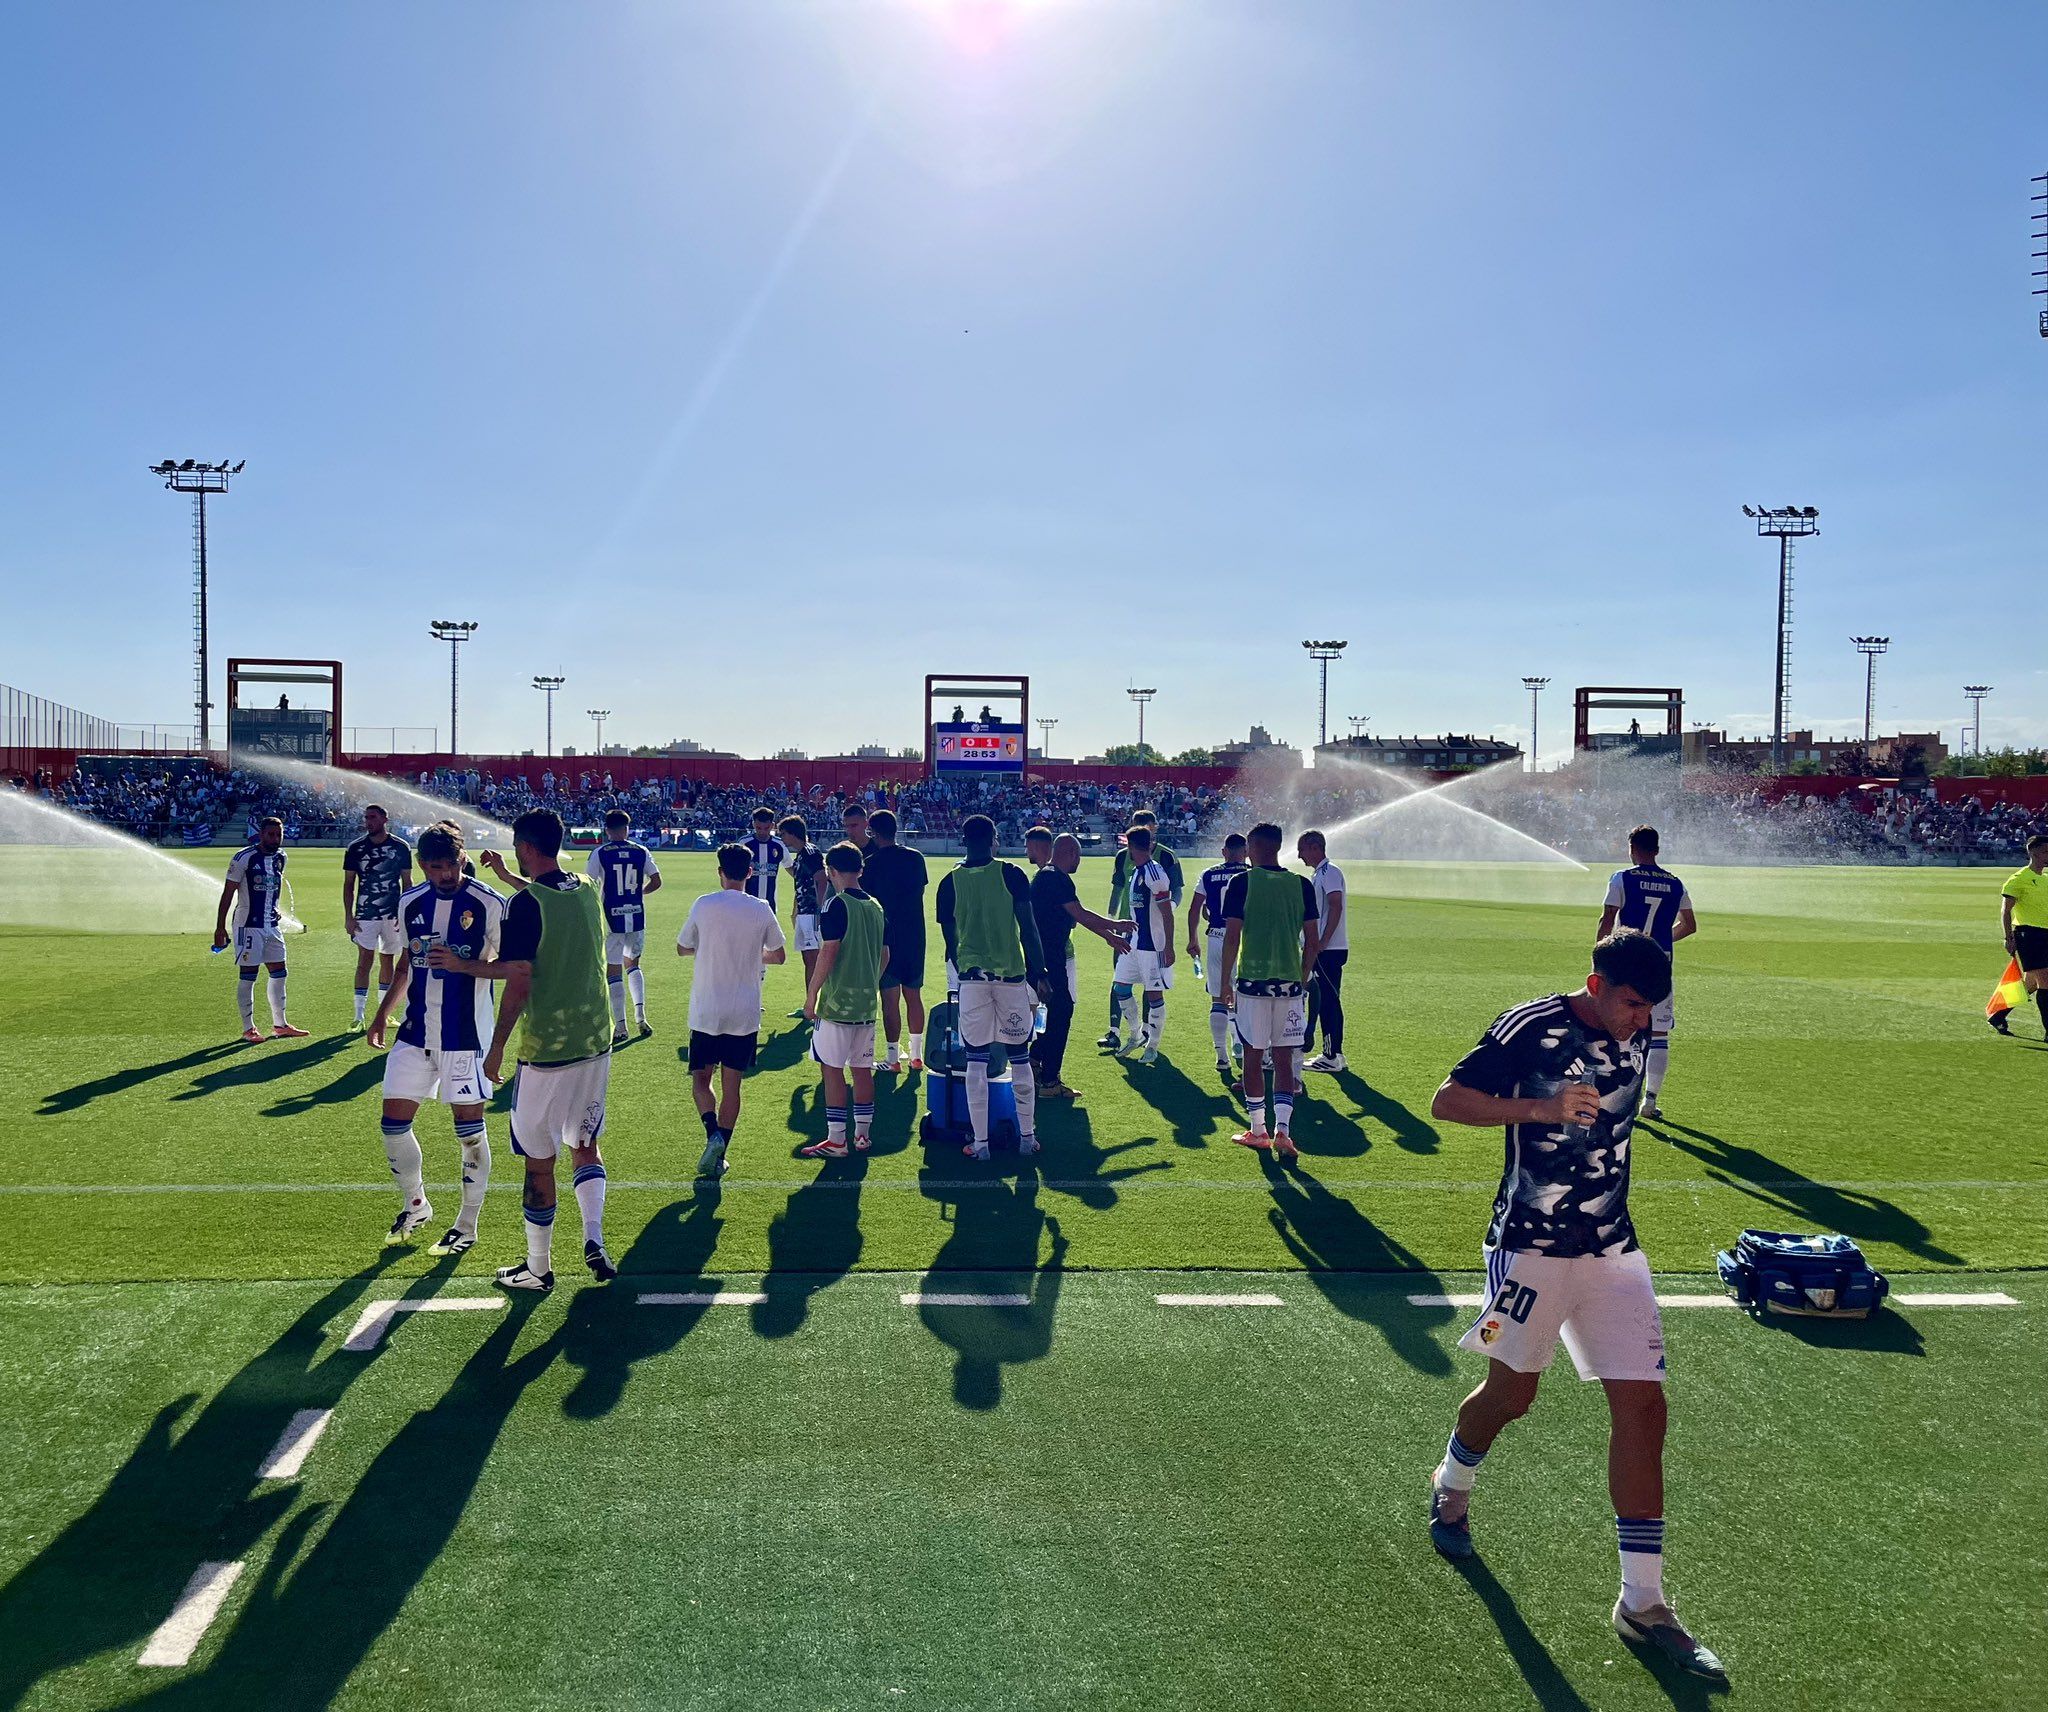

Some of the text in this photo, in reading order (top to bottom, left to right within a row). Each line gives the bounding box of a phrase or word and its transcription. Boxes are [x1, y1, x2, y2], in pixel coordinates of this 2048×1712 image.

[966, 738, 993, 747] 0 1
[612, 863, 639, 896] 14
[1643, 896, 1663, 937] 7
[246, 936, 253, 949] 3
[1493, 1278, 1538, 1325] 20
